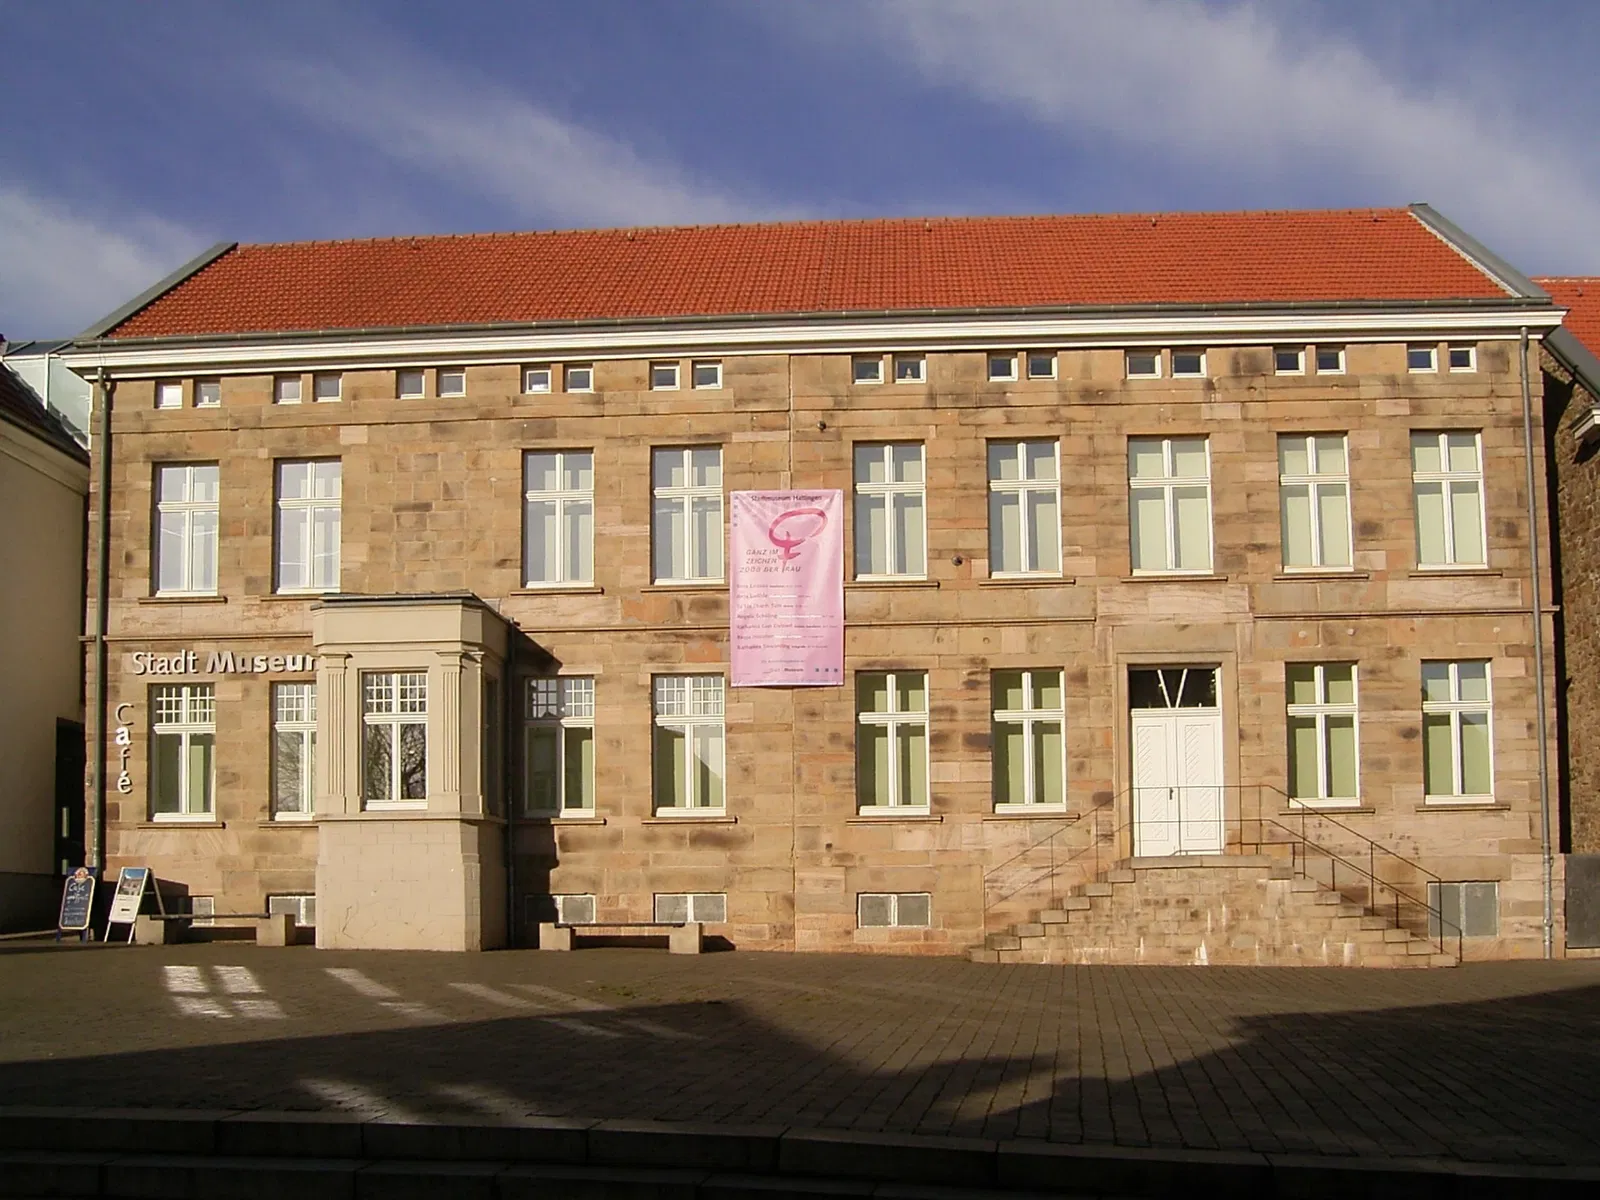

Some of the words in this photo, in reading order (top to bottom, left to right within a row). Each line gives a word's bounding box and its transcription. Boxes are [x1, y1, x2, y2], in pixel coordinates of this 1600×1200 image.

[769, 548, 779, 556] IM
[132, 649, 198, 675] Stadt
[115, 703, 133, 794] Café
